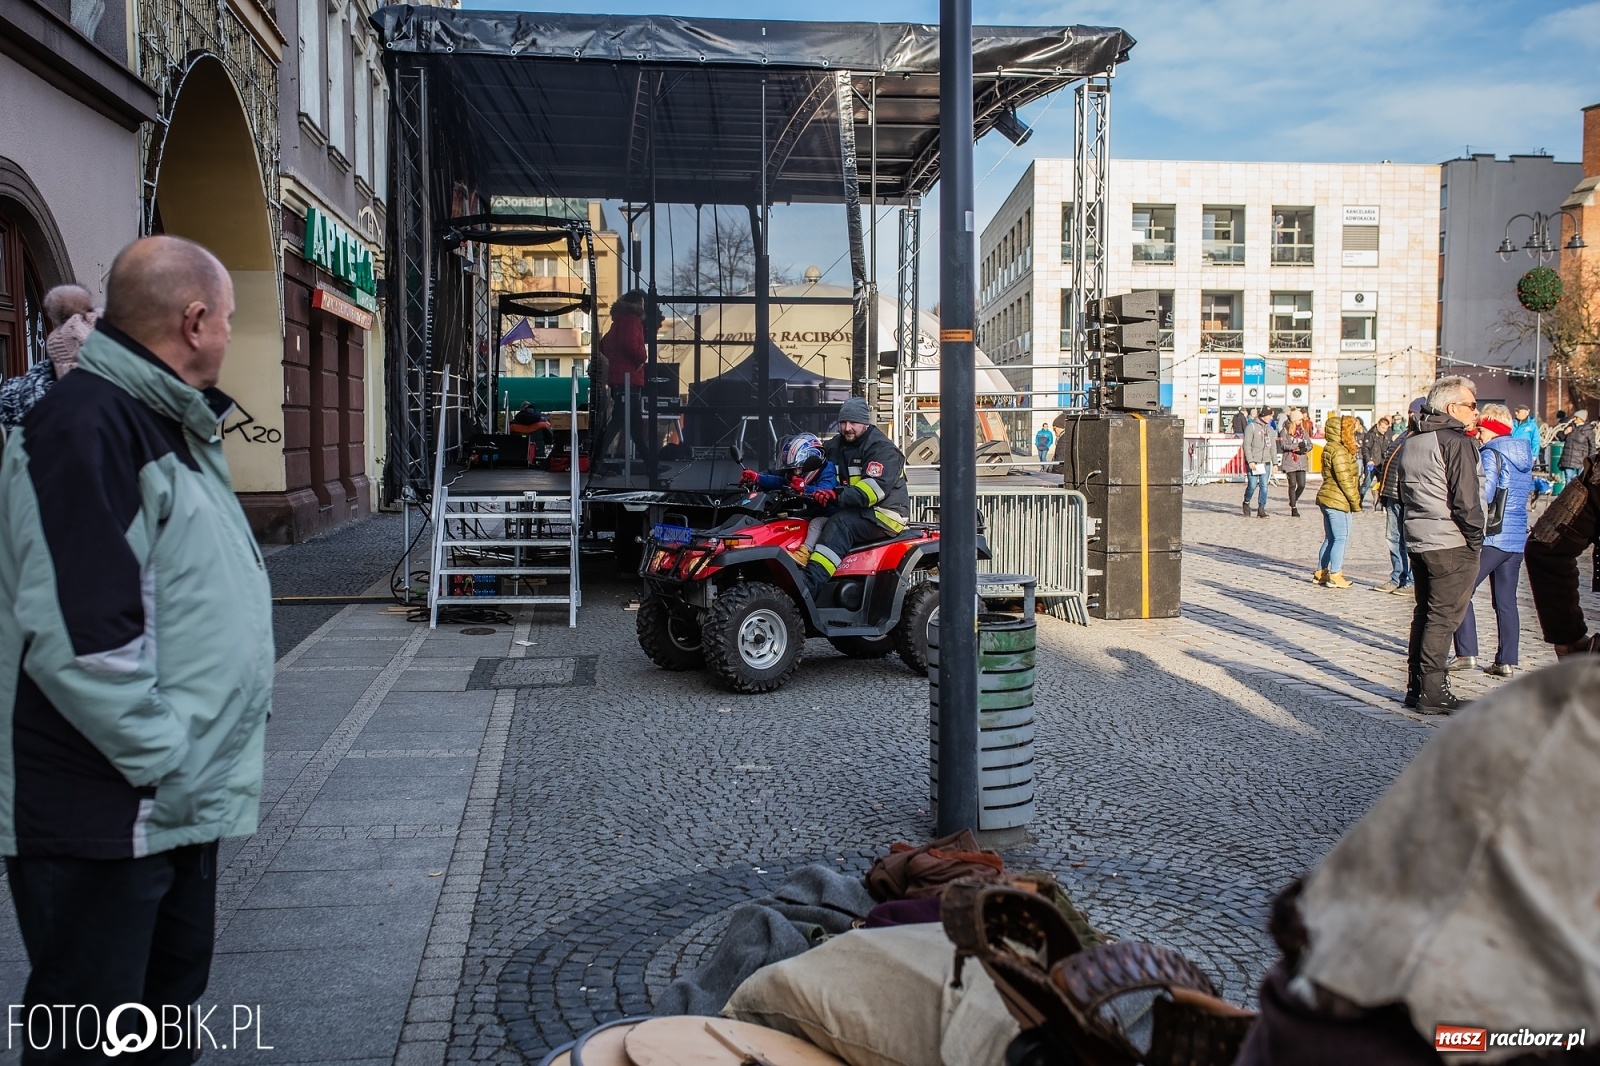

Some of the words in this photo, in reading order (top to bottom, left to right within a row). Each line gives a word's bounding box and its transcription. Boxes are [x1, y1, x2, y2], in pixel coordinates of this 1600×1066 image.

[490, 197, 553, 207] cDonalds
[307, 208, 376, 297] APTEKA
[705, 331, 777, 345] BROWR
[781, 329, 853, 343] RACIBÓR
